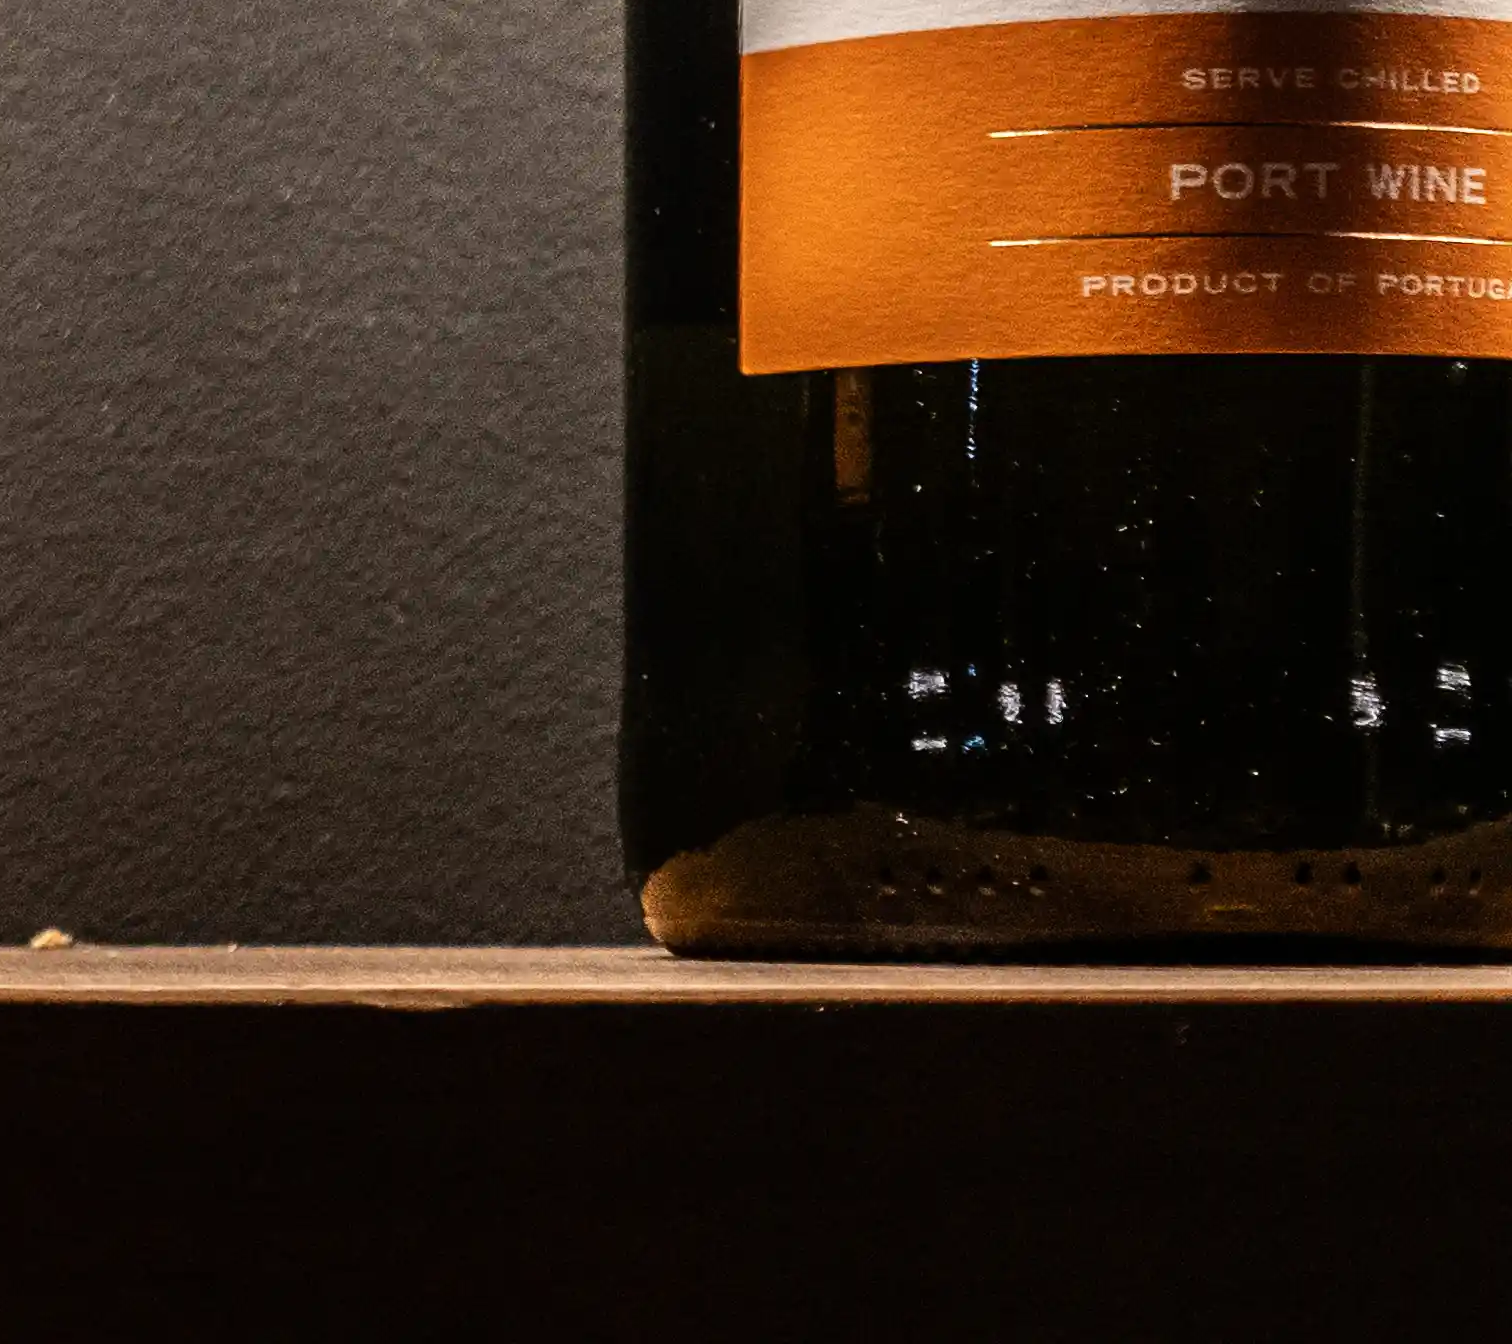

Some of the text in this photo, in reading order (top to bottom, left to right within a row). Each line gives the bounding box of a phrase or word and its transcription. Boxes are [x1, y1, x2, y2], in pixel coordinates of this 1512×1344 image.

[1181, 67, 1482, 96] SERVE CHILLED
[1169, 161, 1488, 207] PORT WINE
[1080, 272, 1286, 298] PRODUCT
[1307, 271, 1358, 295] OF
